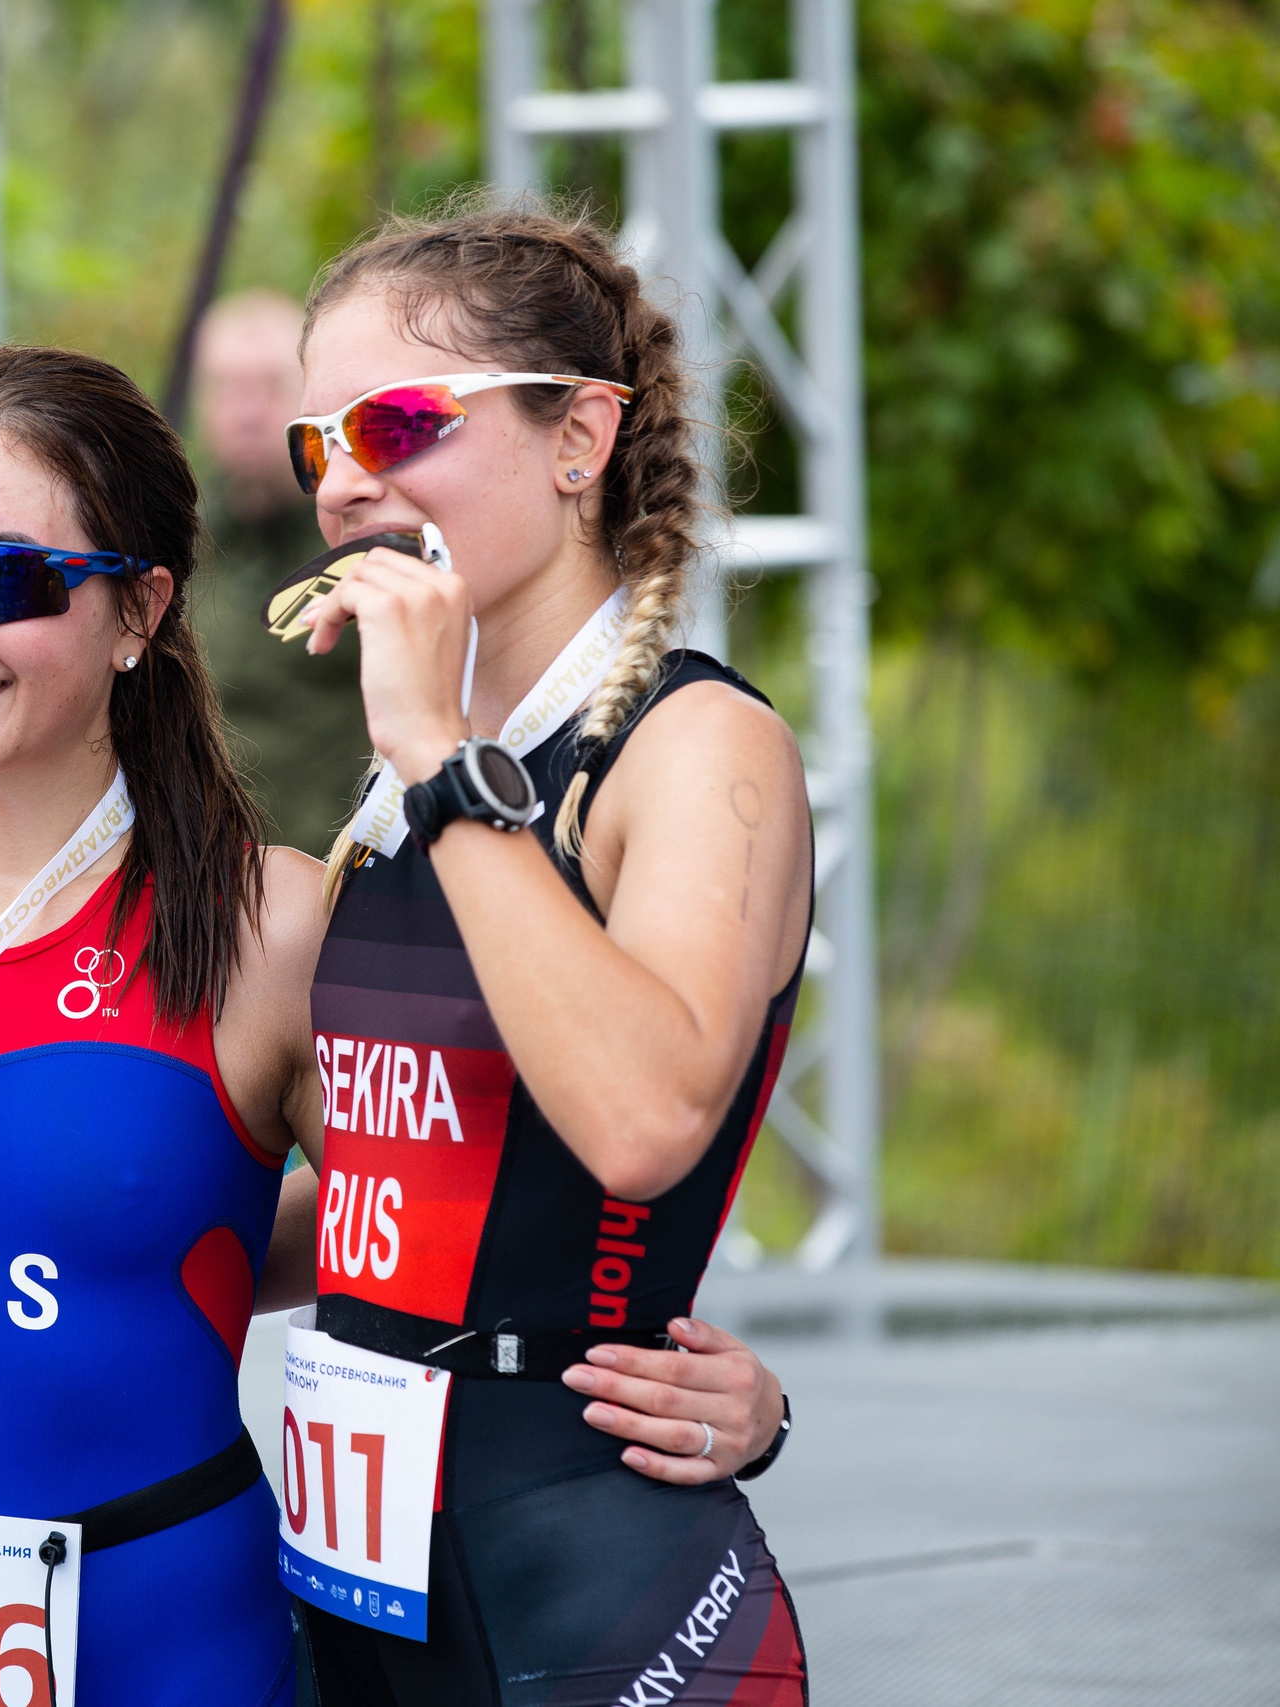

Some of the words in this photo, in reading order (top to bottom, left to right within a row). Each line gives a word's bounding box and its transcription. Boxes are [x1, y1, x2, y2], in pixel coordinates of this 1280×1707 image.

[102, 1008, 119, 1017] ITU
[315, 1034, 464, 1143] SEKIRA
[320, 1170, 402, 1280] RUS
[588, 1188, 651, 1328] hlon
[319, 1363, 407, 1390] СОРЕВНОВАНИЯ
[283, 1405, 385, 1564] 011
[609, 1652, 686, 1707] KIY
[674, 1549, 746, 1658] KRAY
